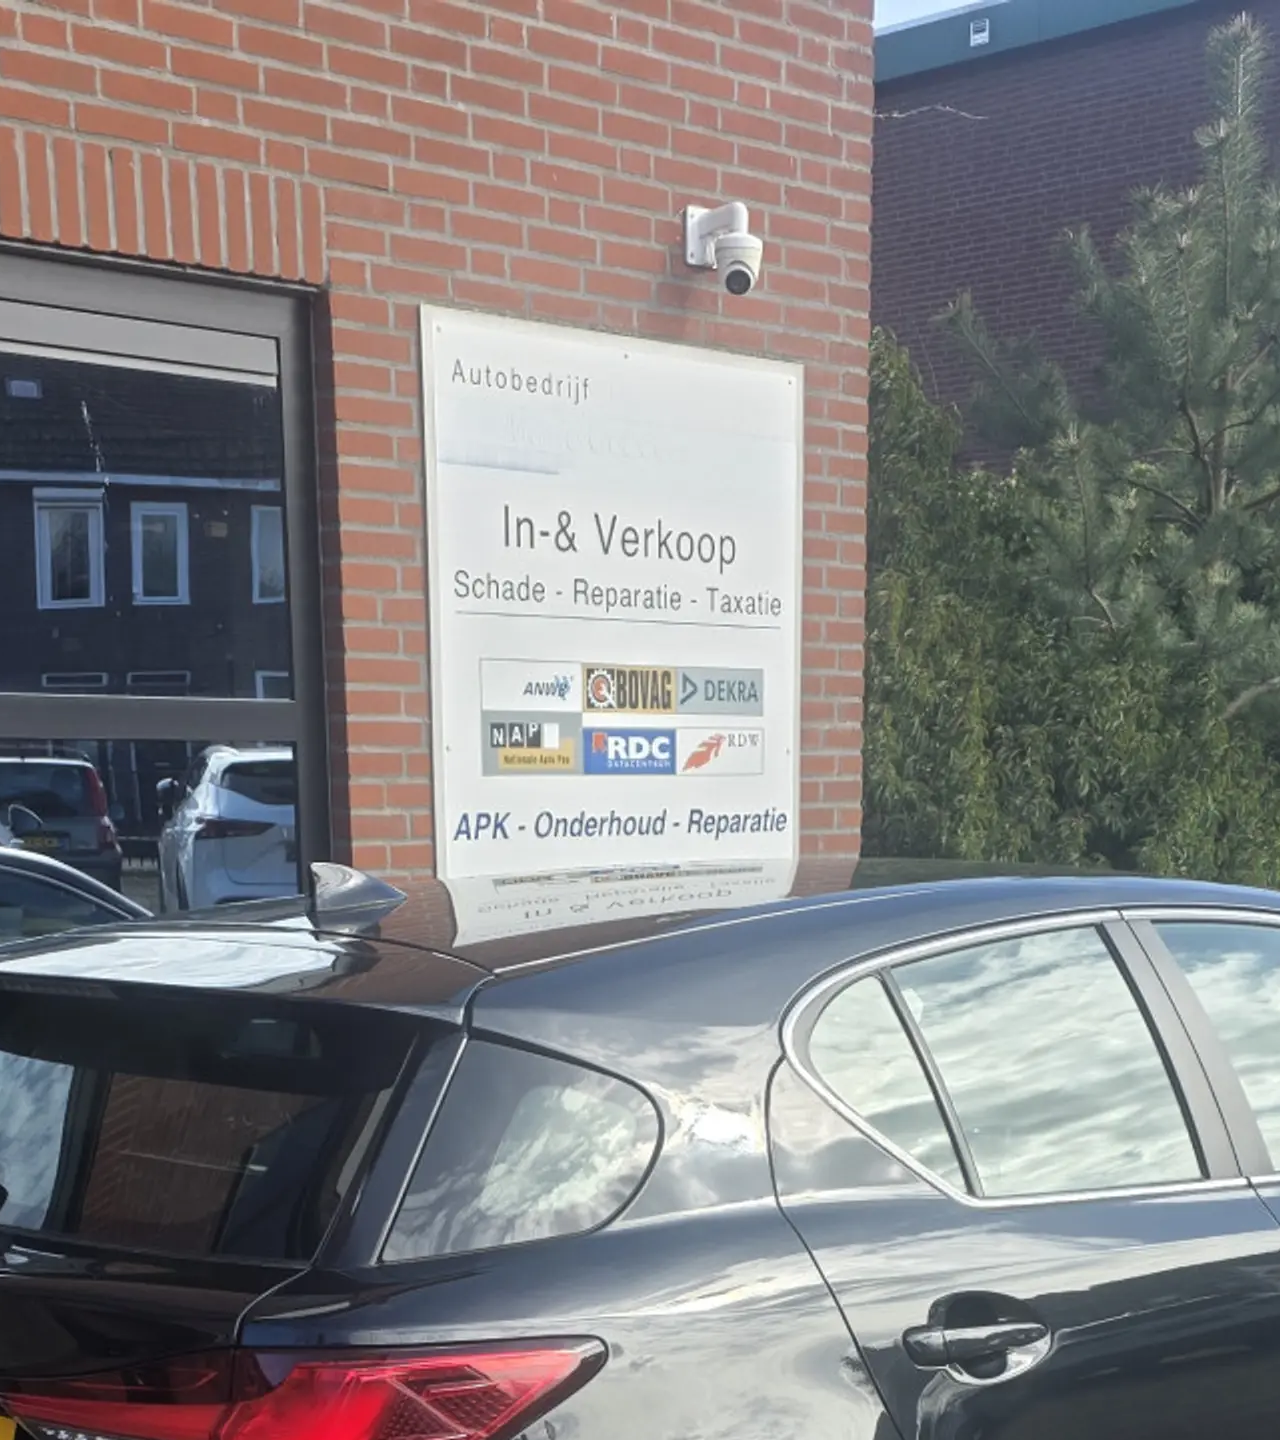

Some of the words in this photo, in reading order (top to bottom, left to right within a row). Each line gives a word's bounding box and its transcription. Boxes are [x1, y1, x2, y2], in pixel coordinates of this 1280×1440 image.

[452, 358, 590, 405] Autobedrijf
[593, 511, 737, 575] Verkoop
[453, 569, 546, 600] Schade
[573, 578, 682, 613] Reparatie
[706, 587, 783, 616] Taxatie
[616, 669, 672, 709] BOVAG
[704, 679, 759, 703] DEKRA
[492, 722, 538, 745] NAP
[607, 735, 670, 760] RDC
[728, 733, 760, 747] RDW
[454, 811, 511, 841] APK
[534, 808, 667, 839] Onderhoud
[687, 806, 788, 843] Reparatie
